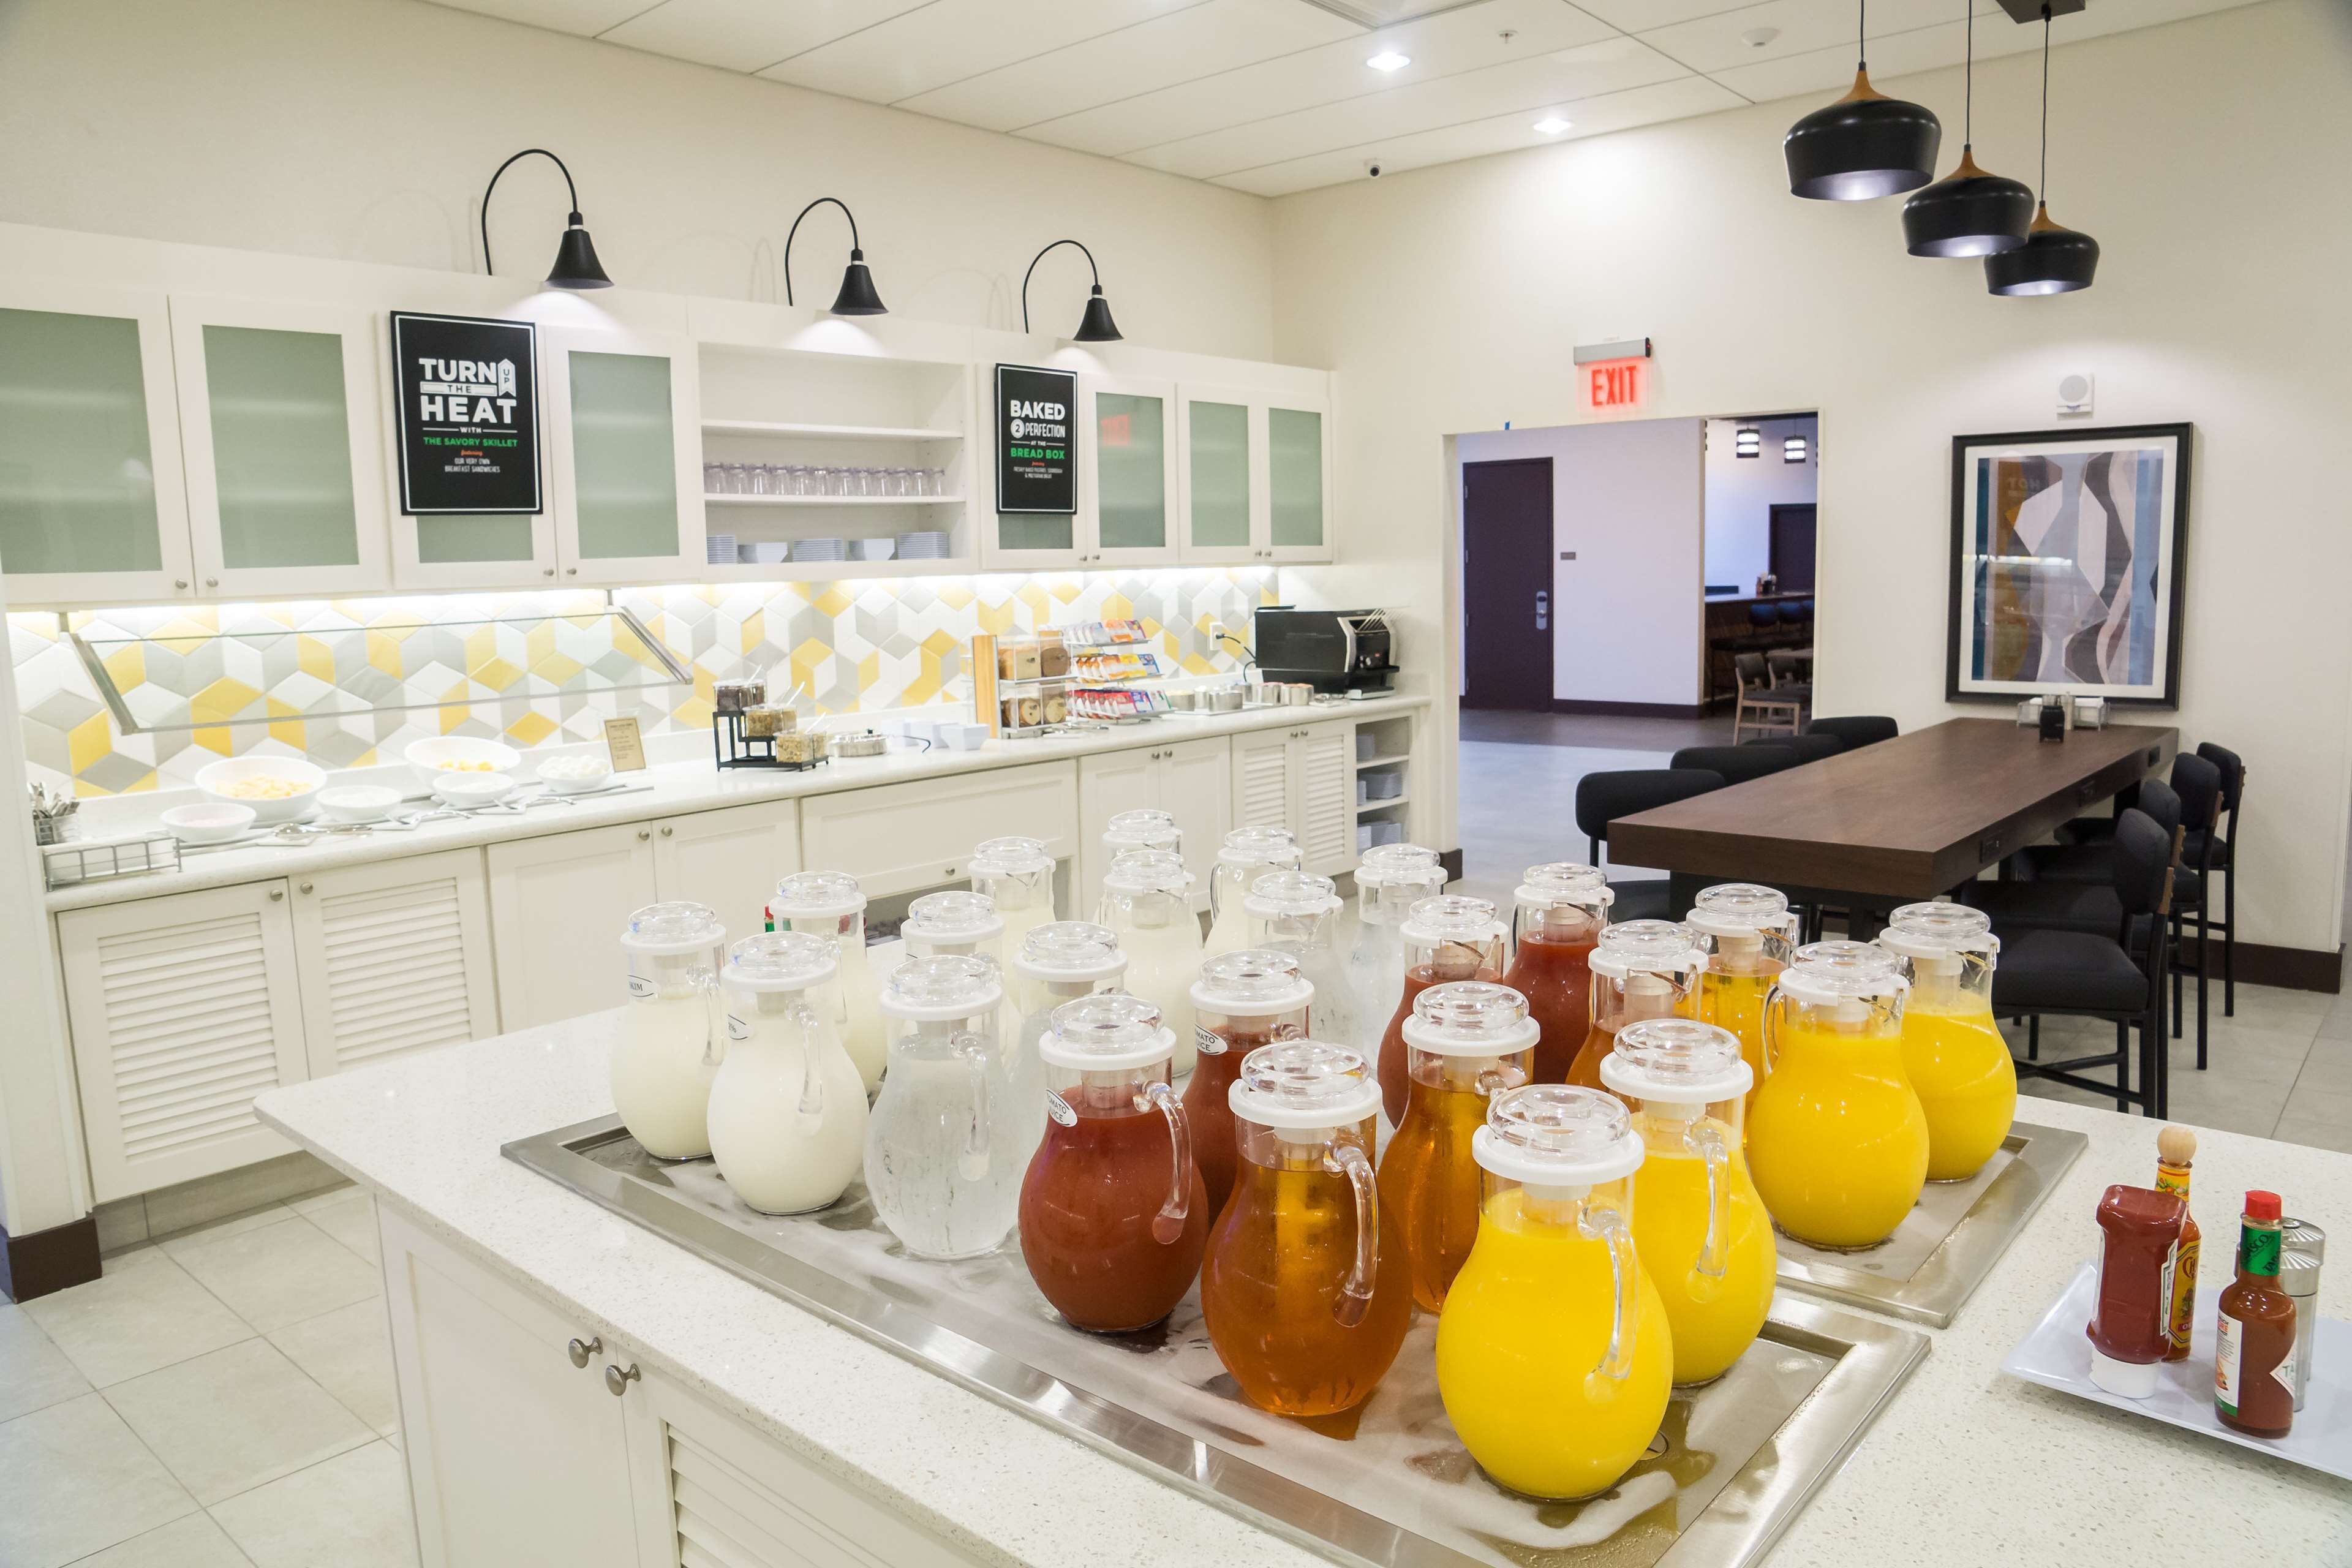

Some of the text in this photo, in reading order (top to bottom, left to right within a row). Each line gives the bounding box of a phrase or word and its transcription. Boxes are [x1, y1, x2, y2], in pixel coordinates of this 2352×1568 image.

[419, 358, 497, 383] TURN
[503, 369, 510, 385] UP
[447, 385, 472, 393] THE
[1592, 366, 1637, 406] EXIT
[421, 395, 517, 424] HEAT
[1010, 400, 1065, 420] BAKED
[1025, 423, 1065, 438] PERFECTION
[1011, 448, 1065, 459] BREAD BOX
[1196, 1029, 1215, 1044] MATO
[1048, 1095, 1066, 1114] OMATO
